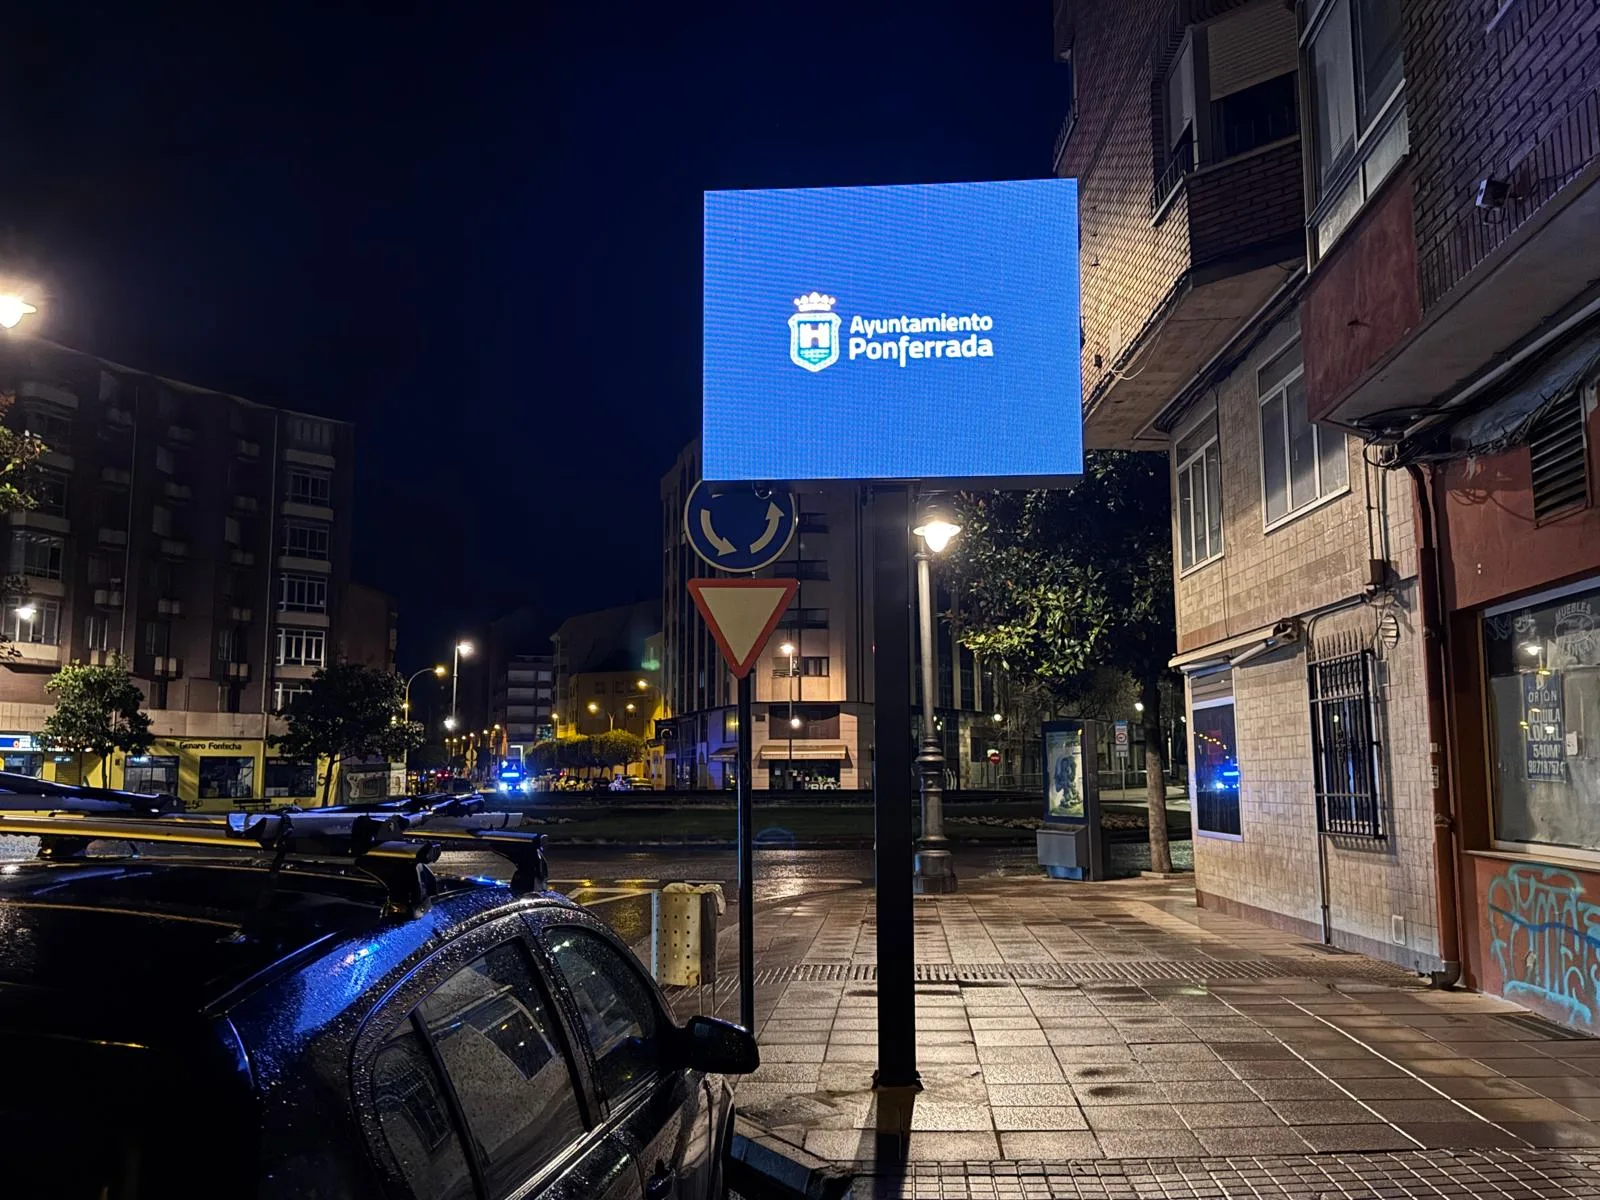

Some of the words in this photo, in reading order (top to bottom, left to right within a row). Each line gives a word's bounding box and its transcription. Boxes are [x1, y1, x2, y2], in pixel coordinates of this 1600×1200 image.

[849, 313, 993, 338] Ayuntamiento
[849, 333, 994, 368] Ponferrada
[1555, 600, 1592, 620] MUEBLES
[1528, 690, 1558, 703] ORION
[1527, 724, 1564, 741] LOCAL
